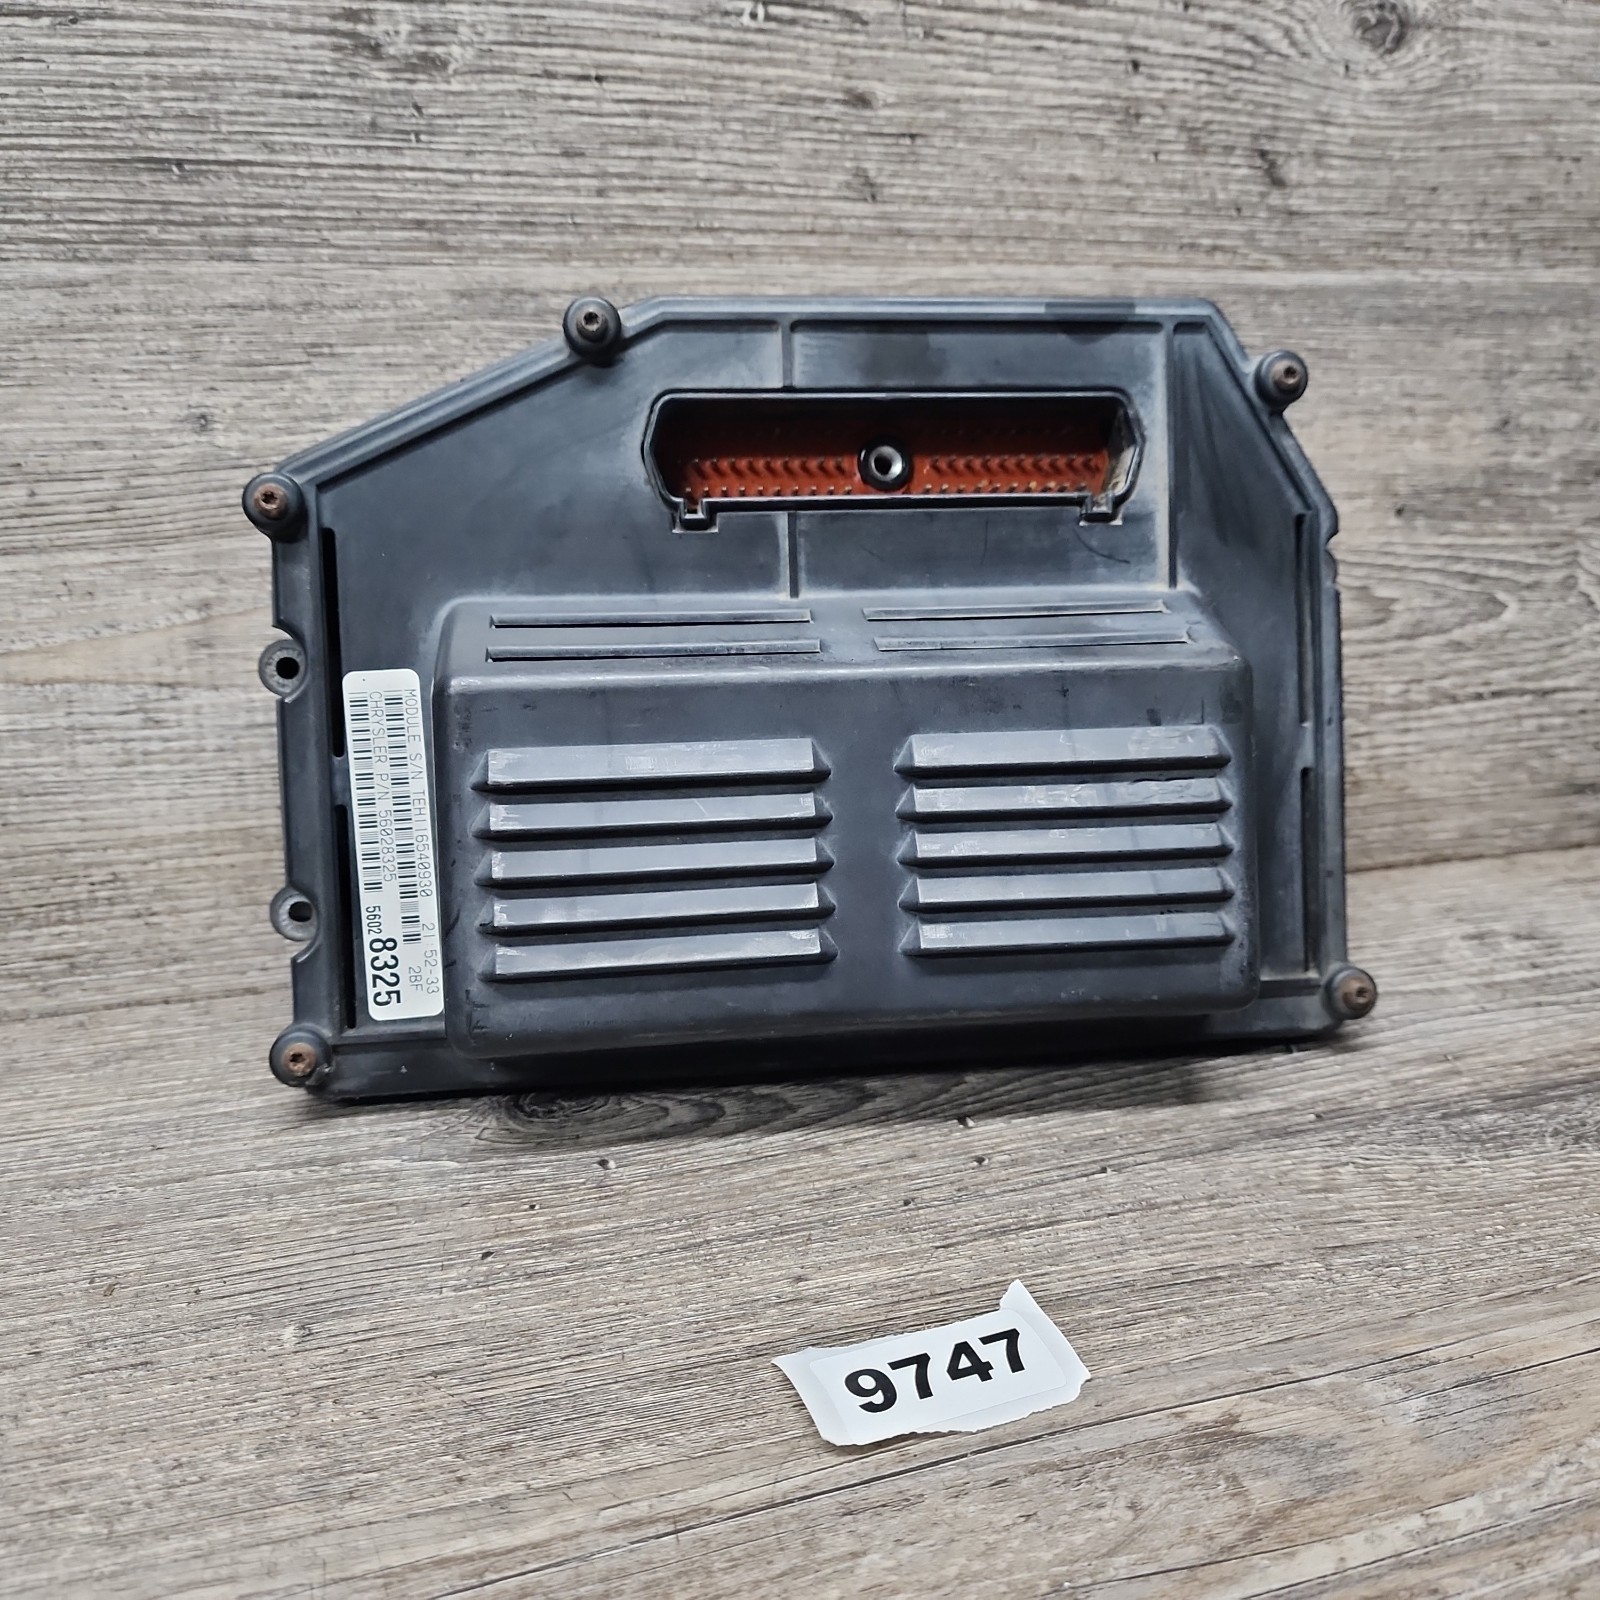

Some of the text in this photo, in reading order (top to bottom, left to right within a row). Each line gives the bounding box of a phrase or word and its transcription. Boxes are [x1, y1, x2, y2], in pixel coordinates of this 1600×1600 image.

[404, 689, 421, 743] MODULE
[369, 691, 397, 882] CHRYSLER P/N 56028325
[409, 753, 424, 780] S/N
[844, 1327, 1026, 1413] 9747
